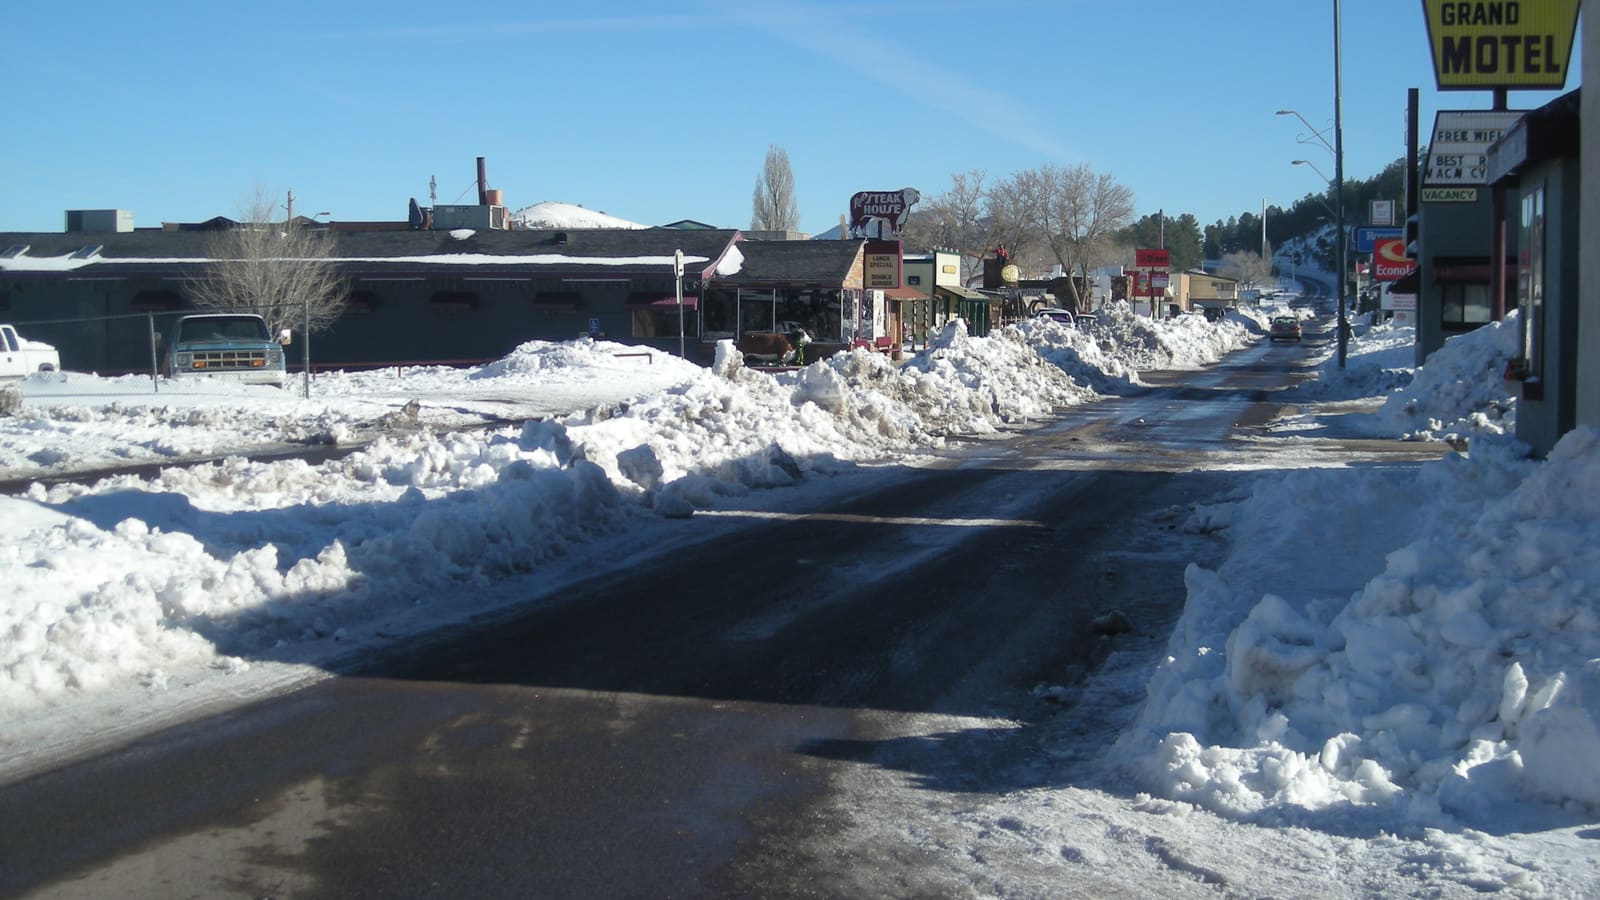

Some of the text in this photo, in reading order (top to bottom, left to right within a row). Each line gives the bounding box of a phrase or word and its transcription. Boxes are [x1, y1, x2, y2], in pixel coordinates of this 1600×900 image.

[1441, 3, 1519, 26] GRAND
[1442, 35, 1560, 74] MOTEL
[1438, 131, 1468, 142] FREE
[1436, 155, 1464, 166] BEST
[864, 193, 901, 204] STEAK
[1424, 190, 1474, 200] VACANCY
[863, 204, 901, 214] HOUSE
